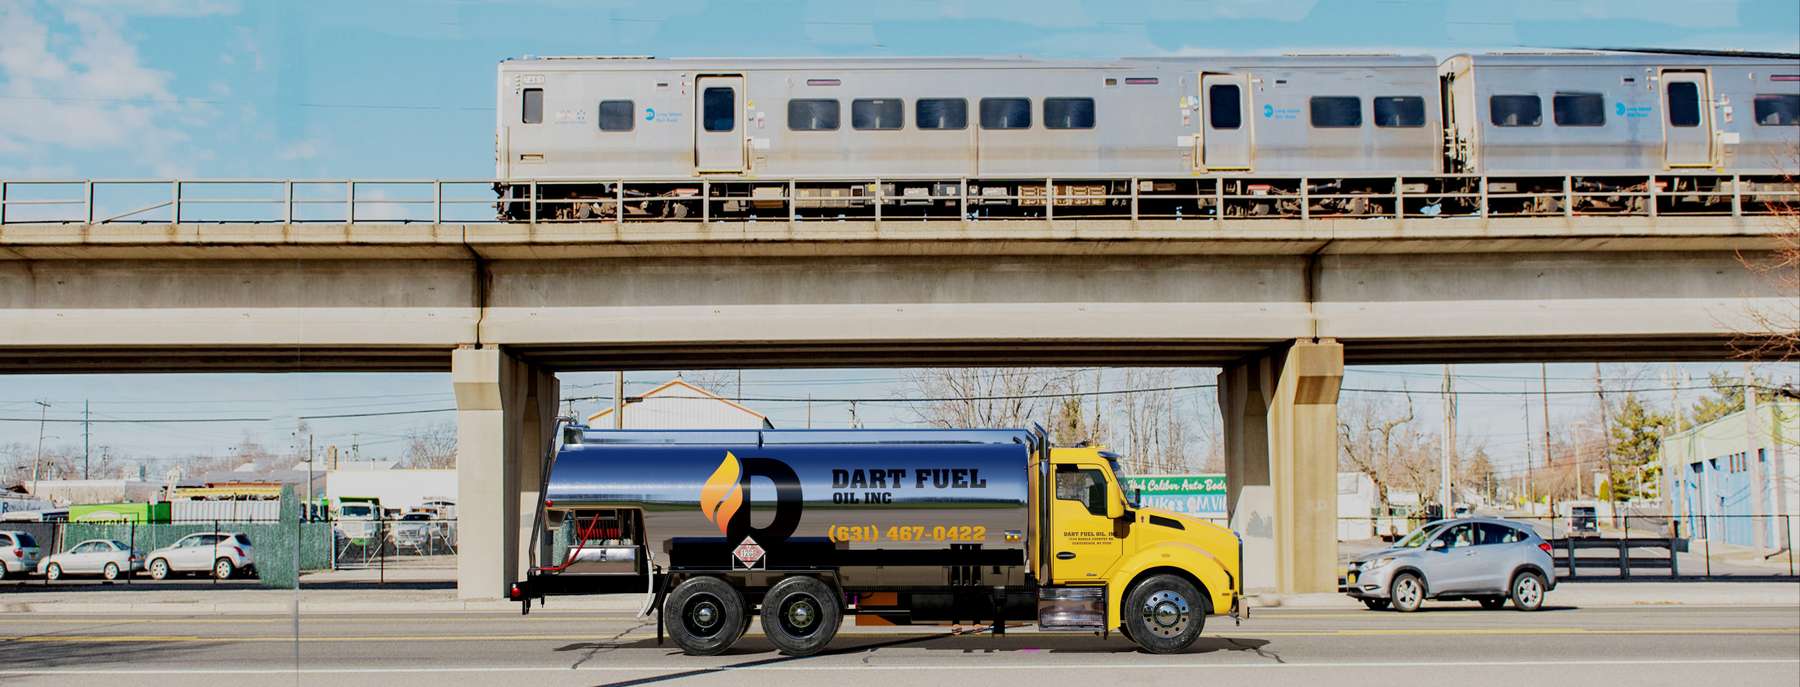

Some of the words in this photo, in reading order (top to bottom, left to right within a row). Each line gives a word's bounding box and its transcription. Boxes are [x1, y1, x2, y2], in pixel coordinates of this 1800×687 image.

[832, 469, 906, 488] DART
[915, 469, 987, 488] FUEL
[1181, 478, 1204, 491] Auto
[832, 492, 859, 504] OIL
[864, 492, 892, 504] INC
[828, 524, 879, 543] (631)
[886, 525, 987, 542] 467-0422
